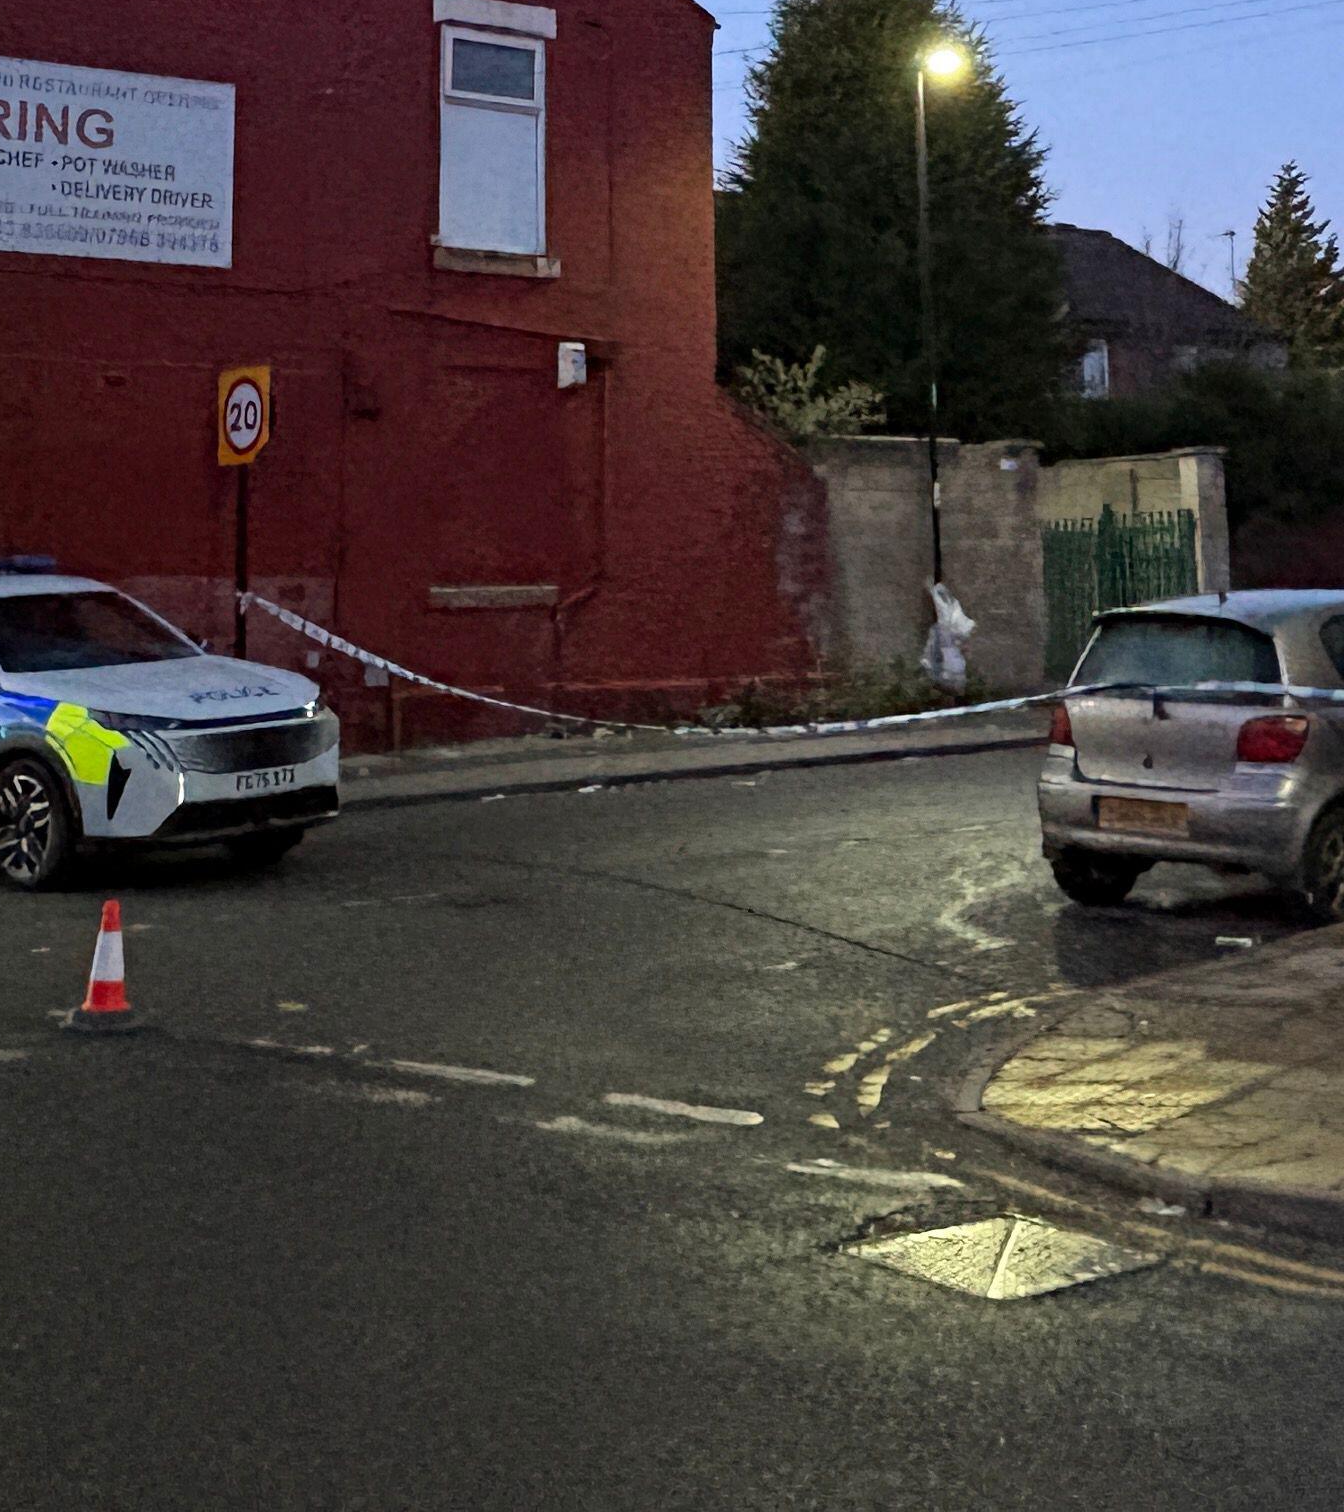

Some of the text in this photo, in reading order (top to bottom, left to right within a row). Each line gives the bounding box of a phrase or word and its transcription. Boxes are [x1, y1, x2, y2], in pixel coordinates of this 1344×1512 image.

[60, 154, 97, 176] POT
[60, 180, 214, 209] DELIVERY DRIVER
[230, 400, 258, 432] 20
